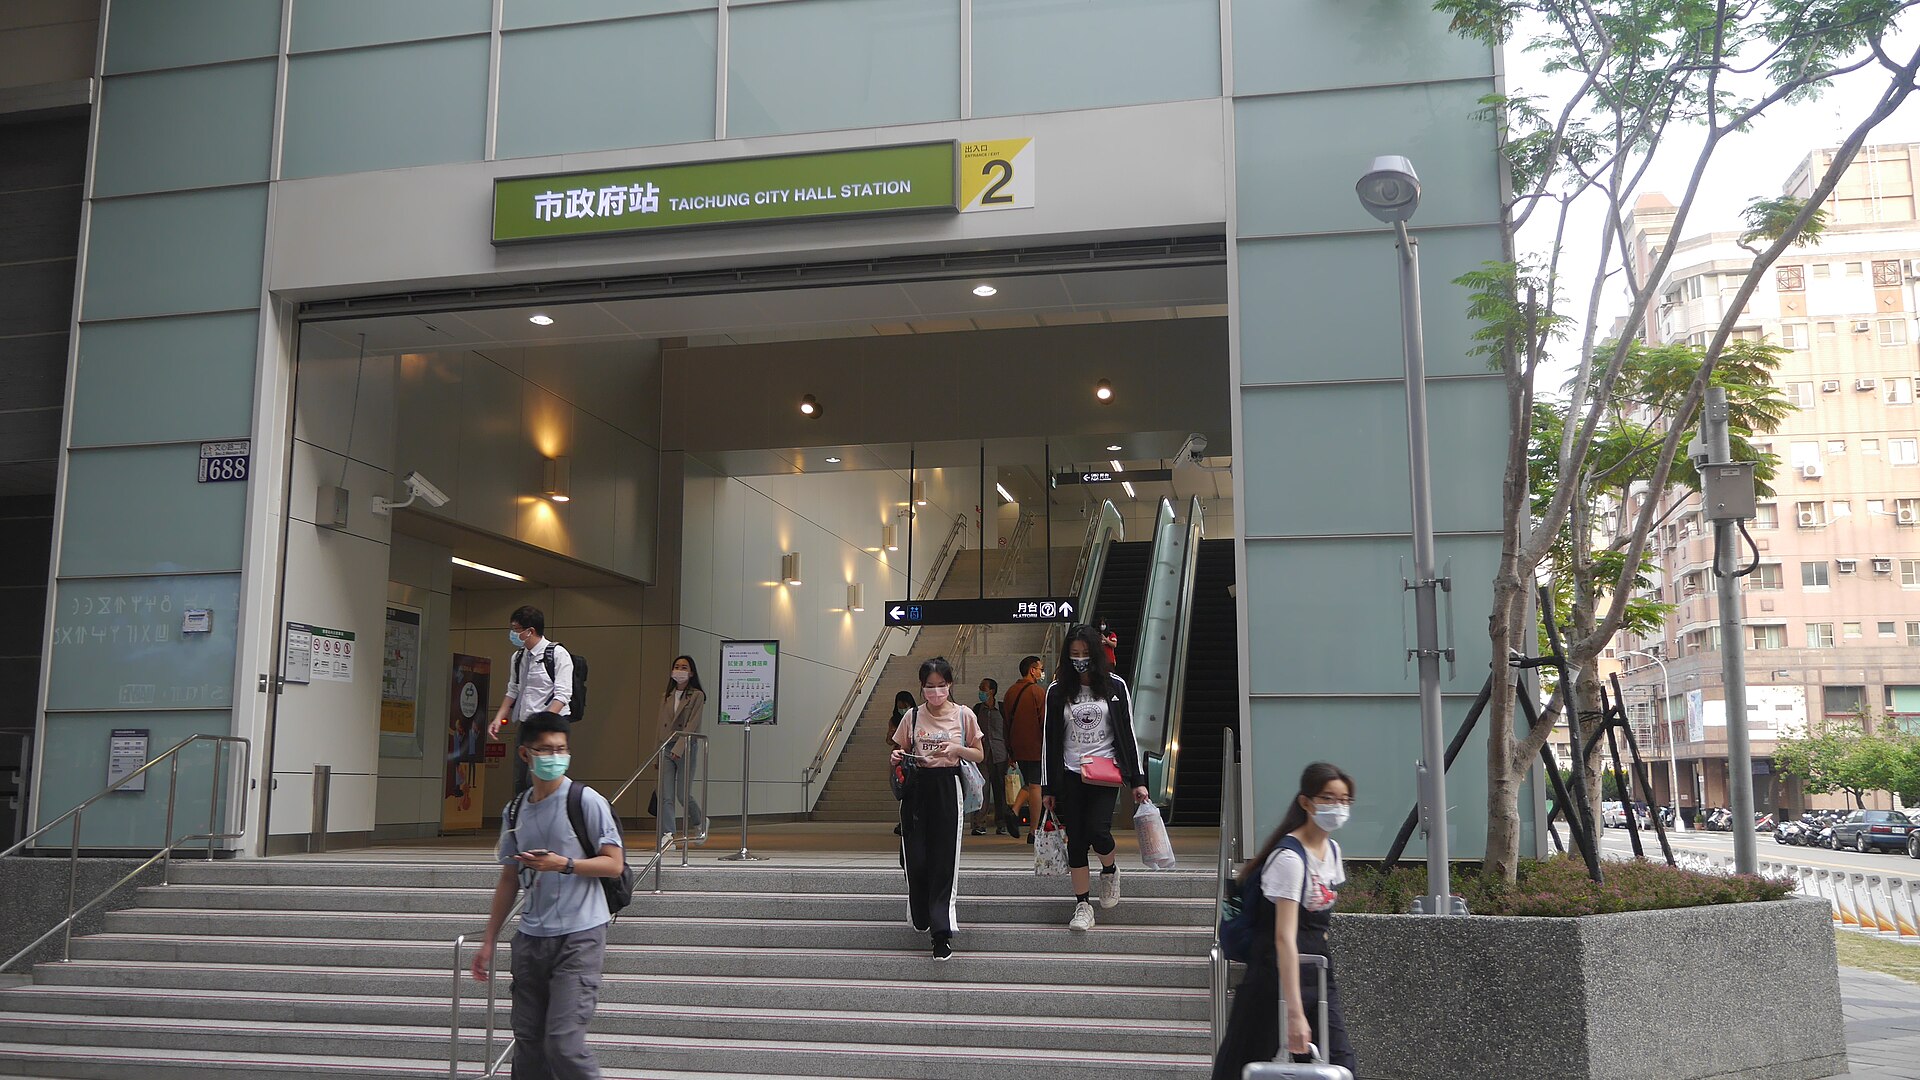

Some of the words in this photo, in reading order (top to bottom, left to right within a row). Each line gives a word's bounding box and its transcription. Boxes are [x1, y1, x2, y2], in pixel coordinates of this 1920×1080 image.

[965, 145, 988, 153] 出入口
[982, 159, 1012, 204] 2
[534, 182, 660, 222] 市政府站
[669, 192, 750, 211] TAICHUNG
[754, 189, 790, 205] CITY
[794, 187, 836, 202] HALL
[840, 180, 911, 198] STATION
[209, 458, 246, 480] 688
[1018, 602, 1037, 613] 月台
